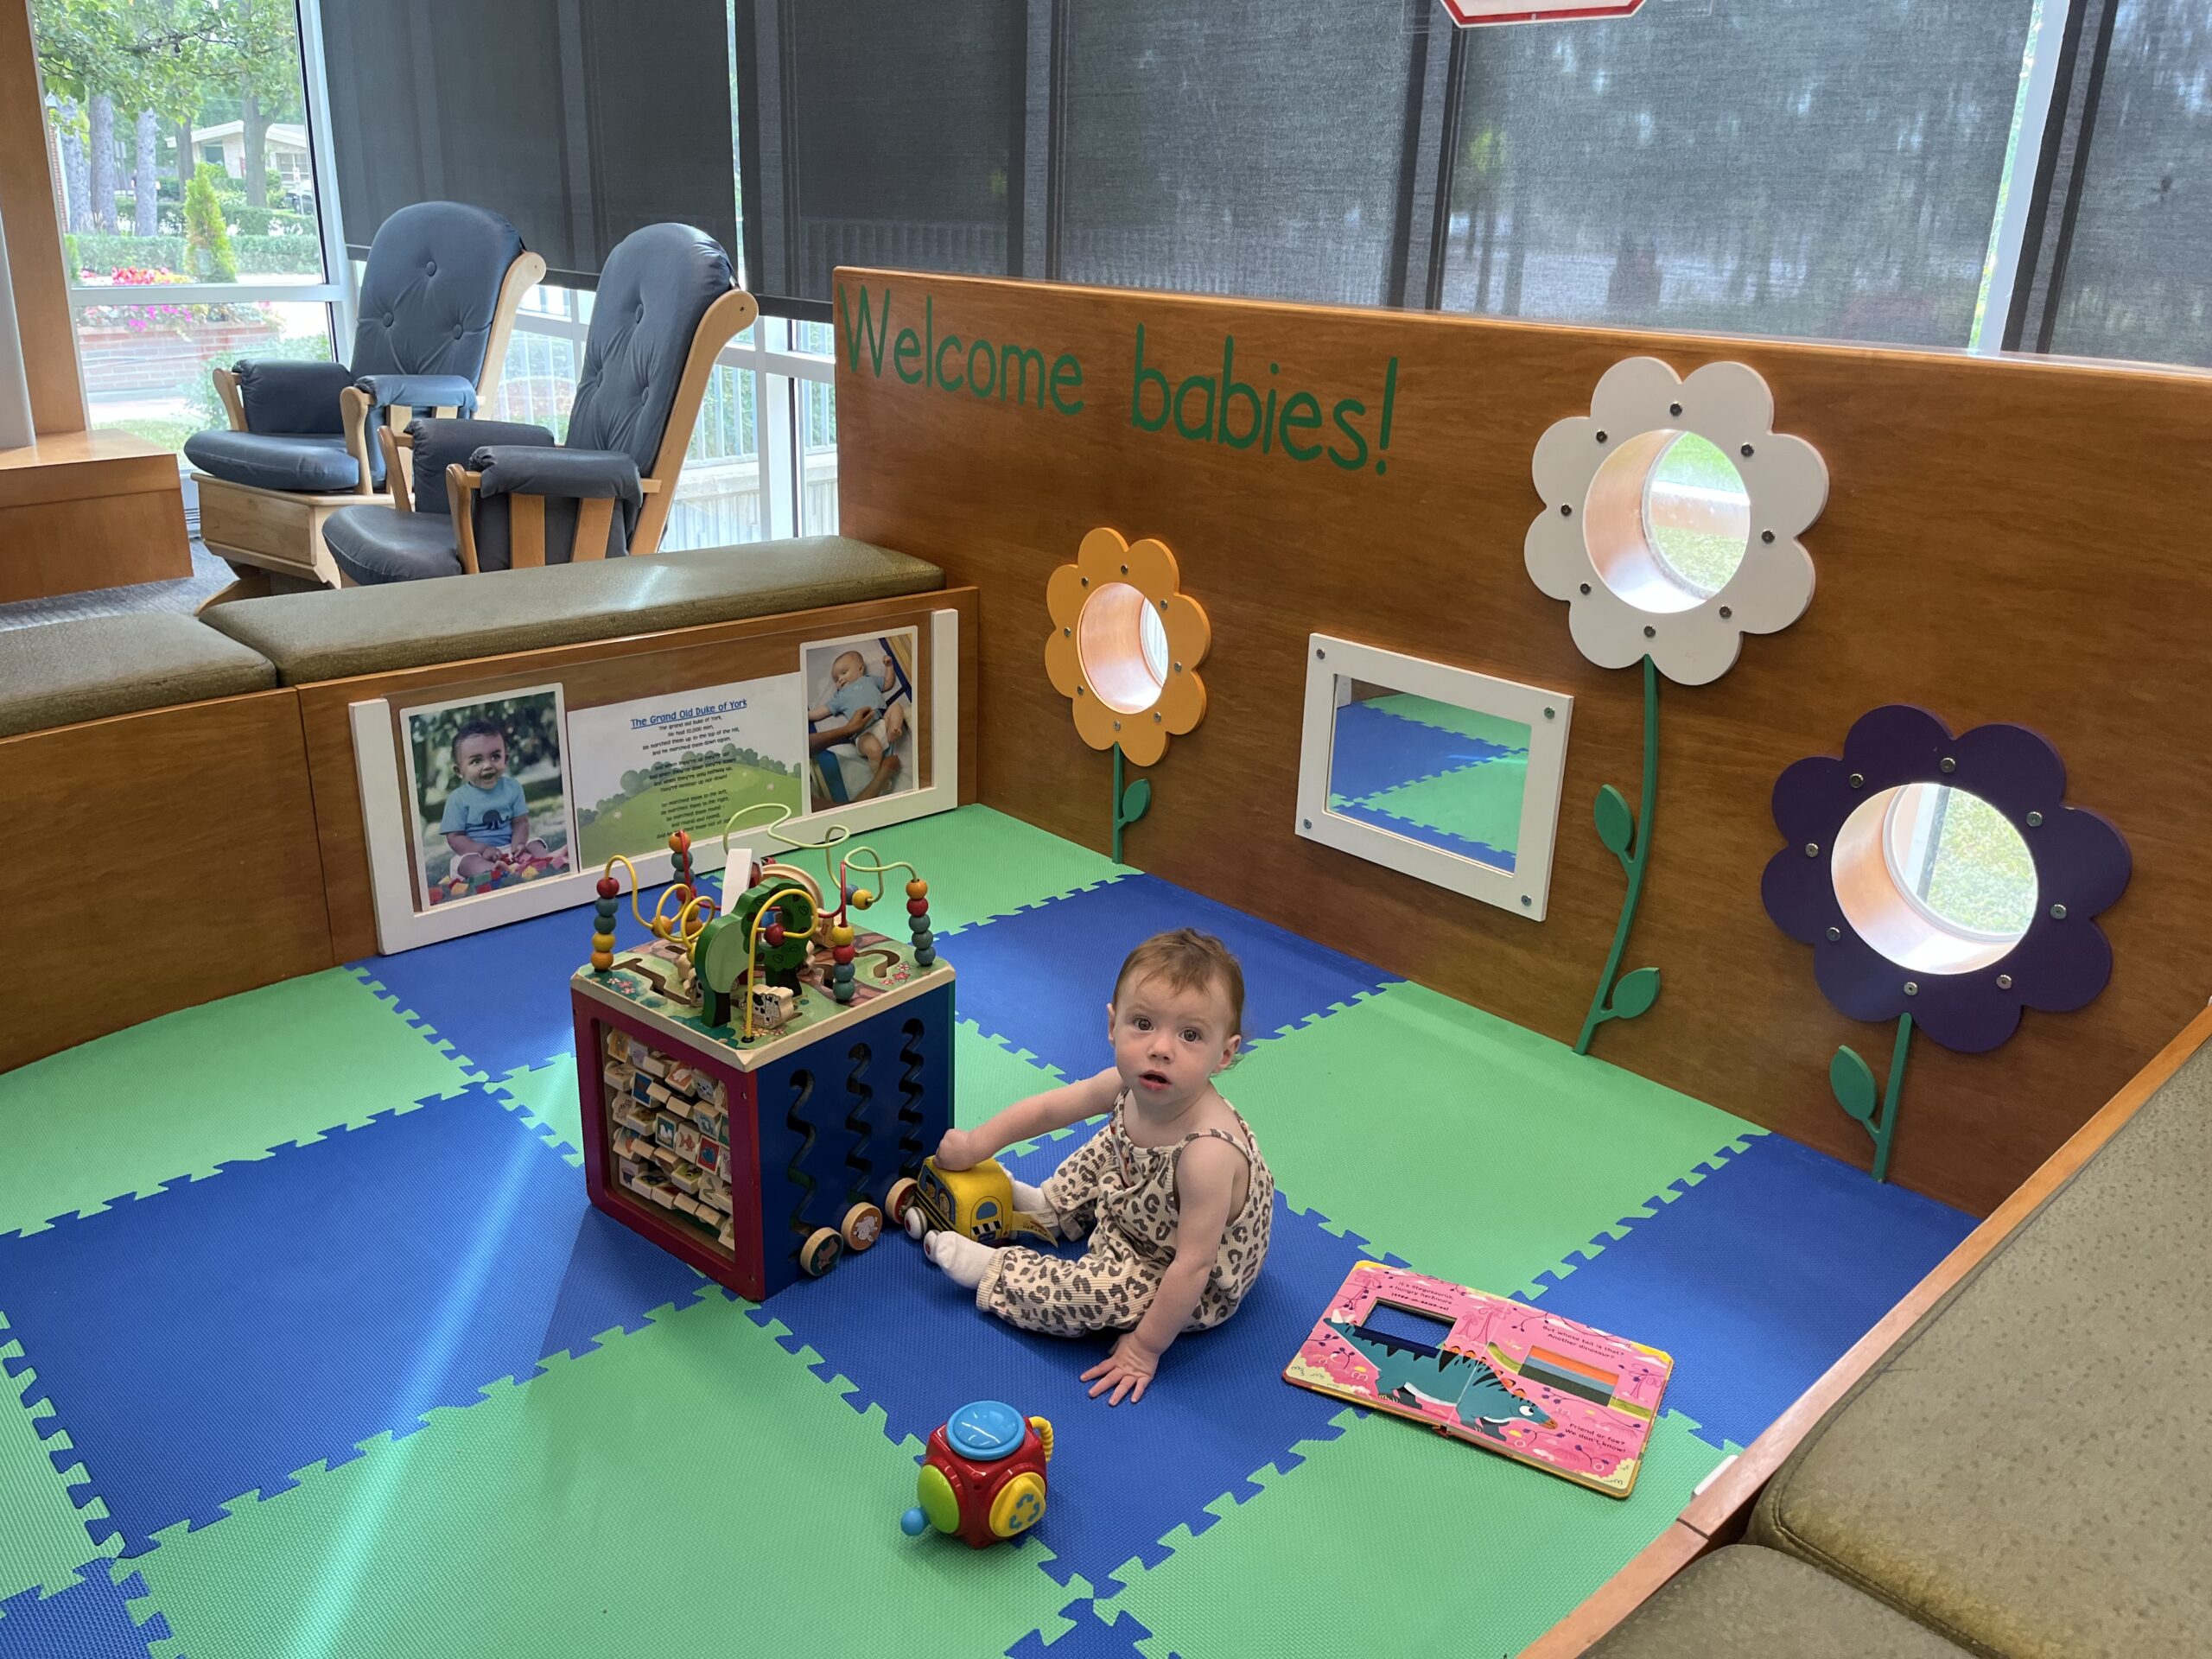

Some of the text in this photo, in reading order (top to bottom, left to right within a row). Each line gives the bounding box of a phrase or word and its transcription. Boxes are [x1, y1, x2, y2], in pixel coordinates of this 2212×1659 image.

[836, 283, 1398, 475] Welcome babies!
[631, 699, 747, 728] The Grand Old Duke of York
[669, 743, 691, 752] marched
[1395, 1286, 1418, 1295] hungry
[1548, 1334, 1615, 1358] Another dinosaur?
[1557, 1331, 1580, 1341] whose
[1604, 1347, 1624, 1356] that?
[1569, 1423, 1595, 1435] Friend
[1608, 1437, 1625, 1445] foe?
[1579, 1434, 1600, 1444] don't
[1602, 1442, 1626, 1452] know!
